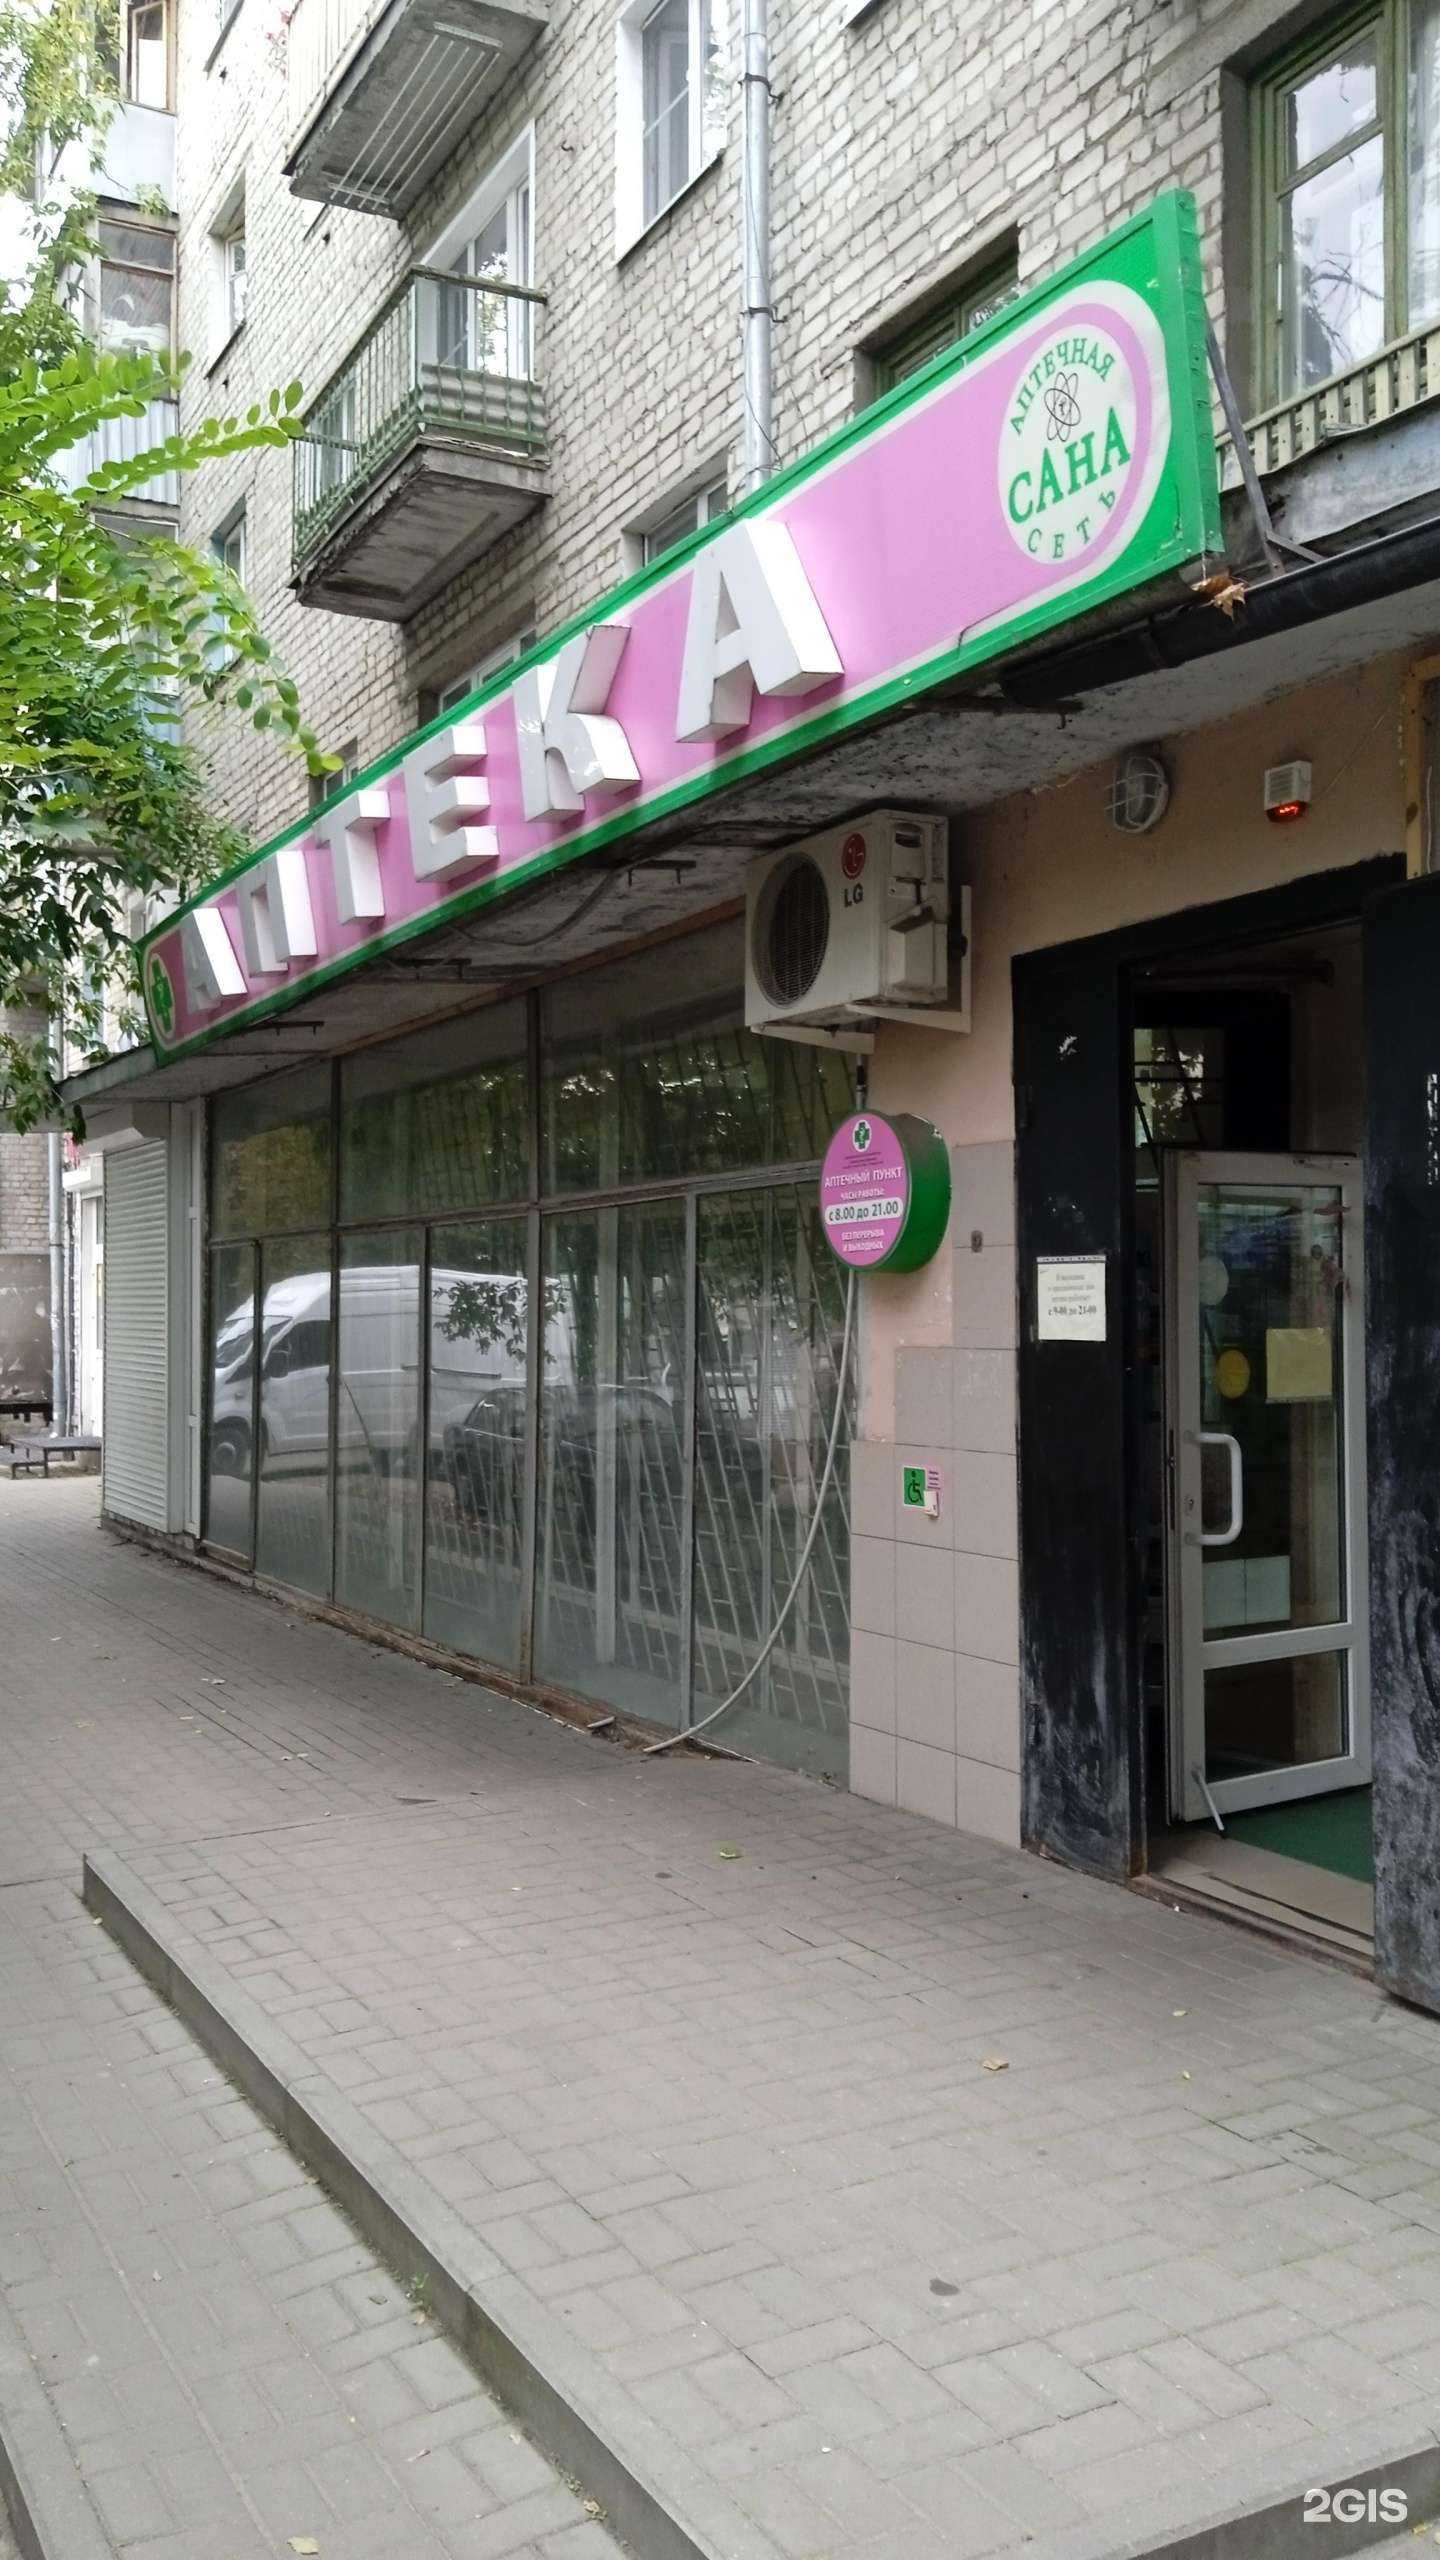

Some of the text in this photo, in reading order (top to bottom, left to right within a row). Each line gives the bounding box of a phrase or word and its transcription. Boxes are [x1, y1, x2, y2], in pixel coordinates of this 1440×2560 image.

[1010, 337, 1116, 436] АПТЕЧНАЯ
[1007, 405, 1131, 524] САНА
[1027, 490, 1116, 559] СЕТЬ
[180, 517, 845, 1016] АПТЕКА
[843, 883, 864, 908] LG
[824, 1167, 903, 1188] АПТЕЧНЫЙ ПУНКТ
[834, 1206, 855, 1221] 8.00
[857, 1207, 869, 1220] до
[872, 1201, 899, 1217] 21.00
